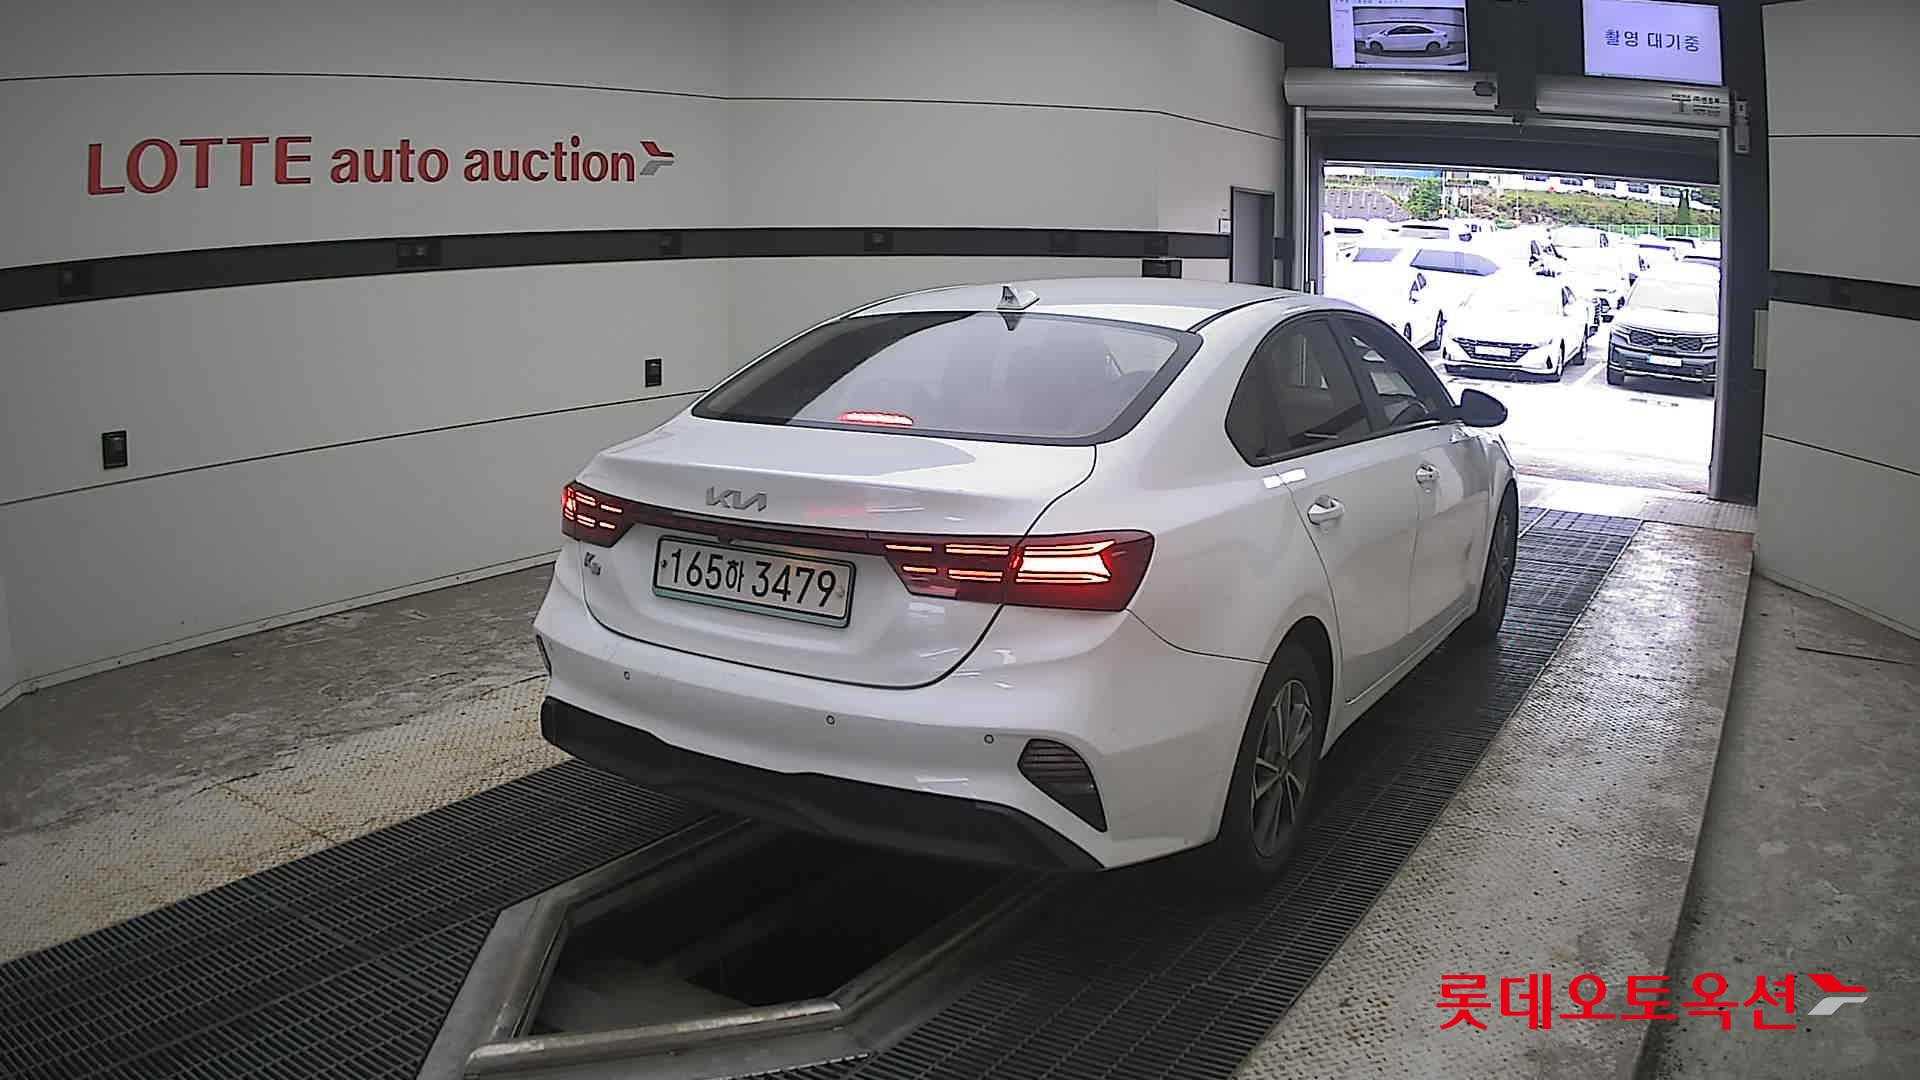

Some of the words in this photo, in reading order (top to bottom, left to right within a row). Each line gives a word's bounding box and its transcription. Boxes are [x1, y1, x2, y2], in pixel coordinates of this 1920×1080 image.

[1604, 29, 1639, 48] 촬영
[1647, 32, 1700, 52] 대기중
[87, 136, 312, 196] LOTTE
[329, 138, 449, 184] auto
[463, 135, 636, 183] auction
[671, 548, 745, 593] 165하
[751, 560, 837, 608] 3479
